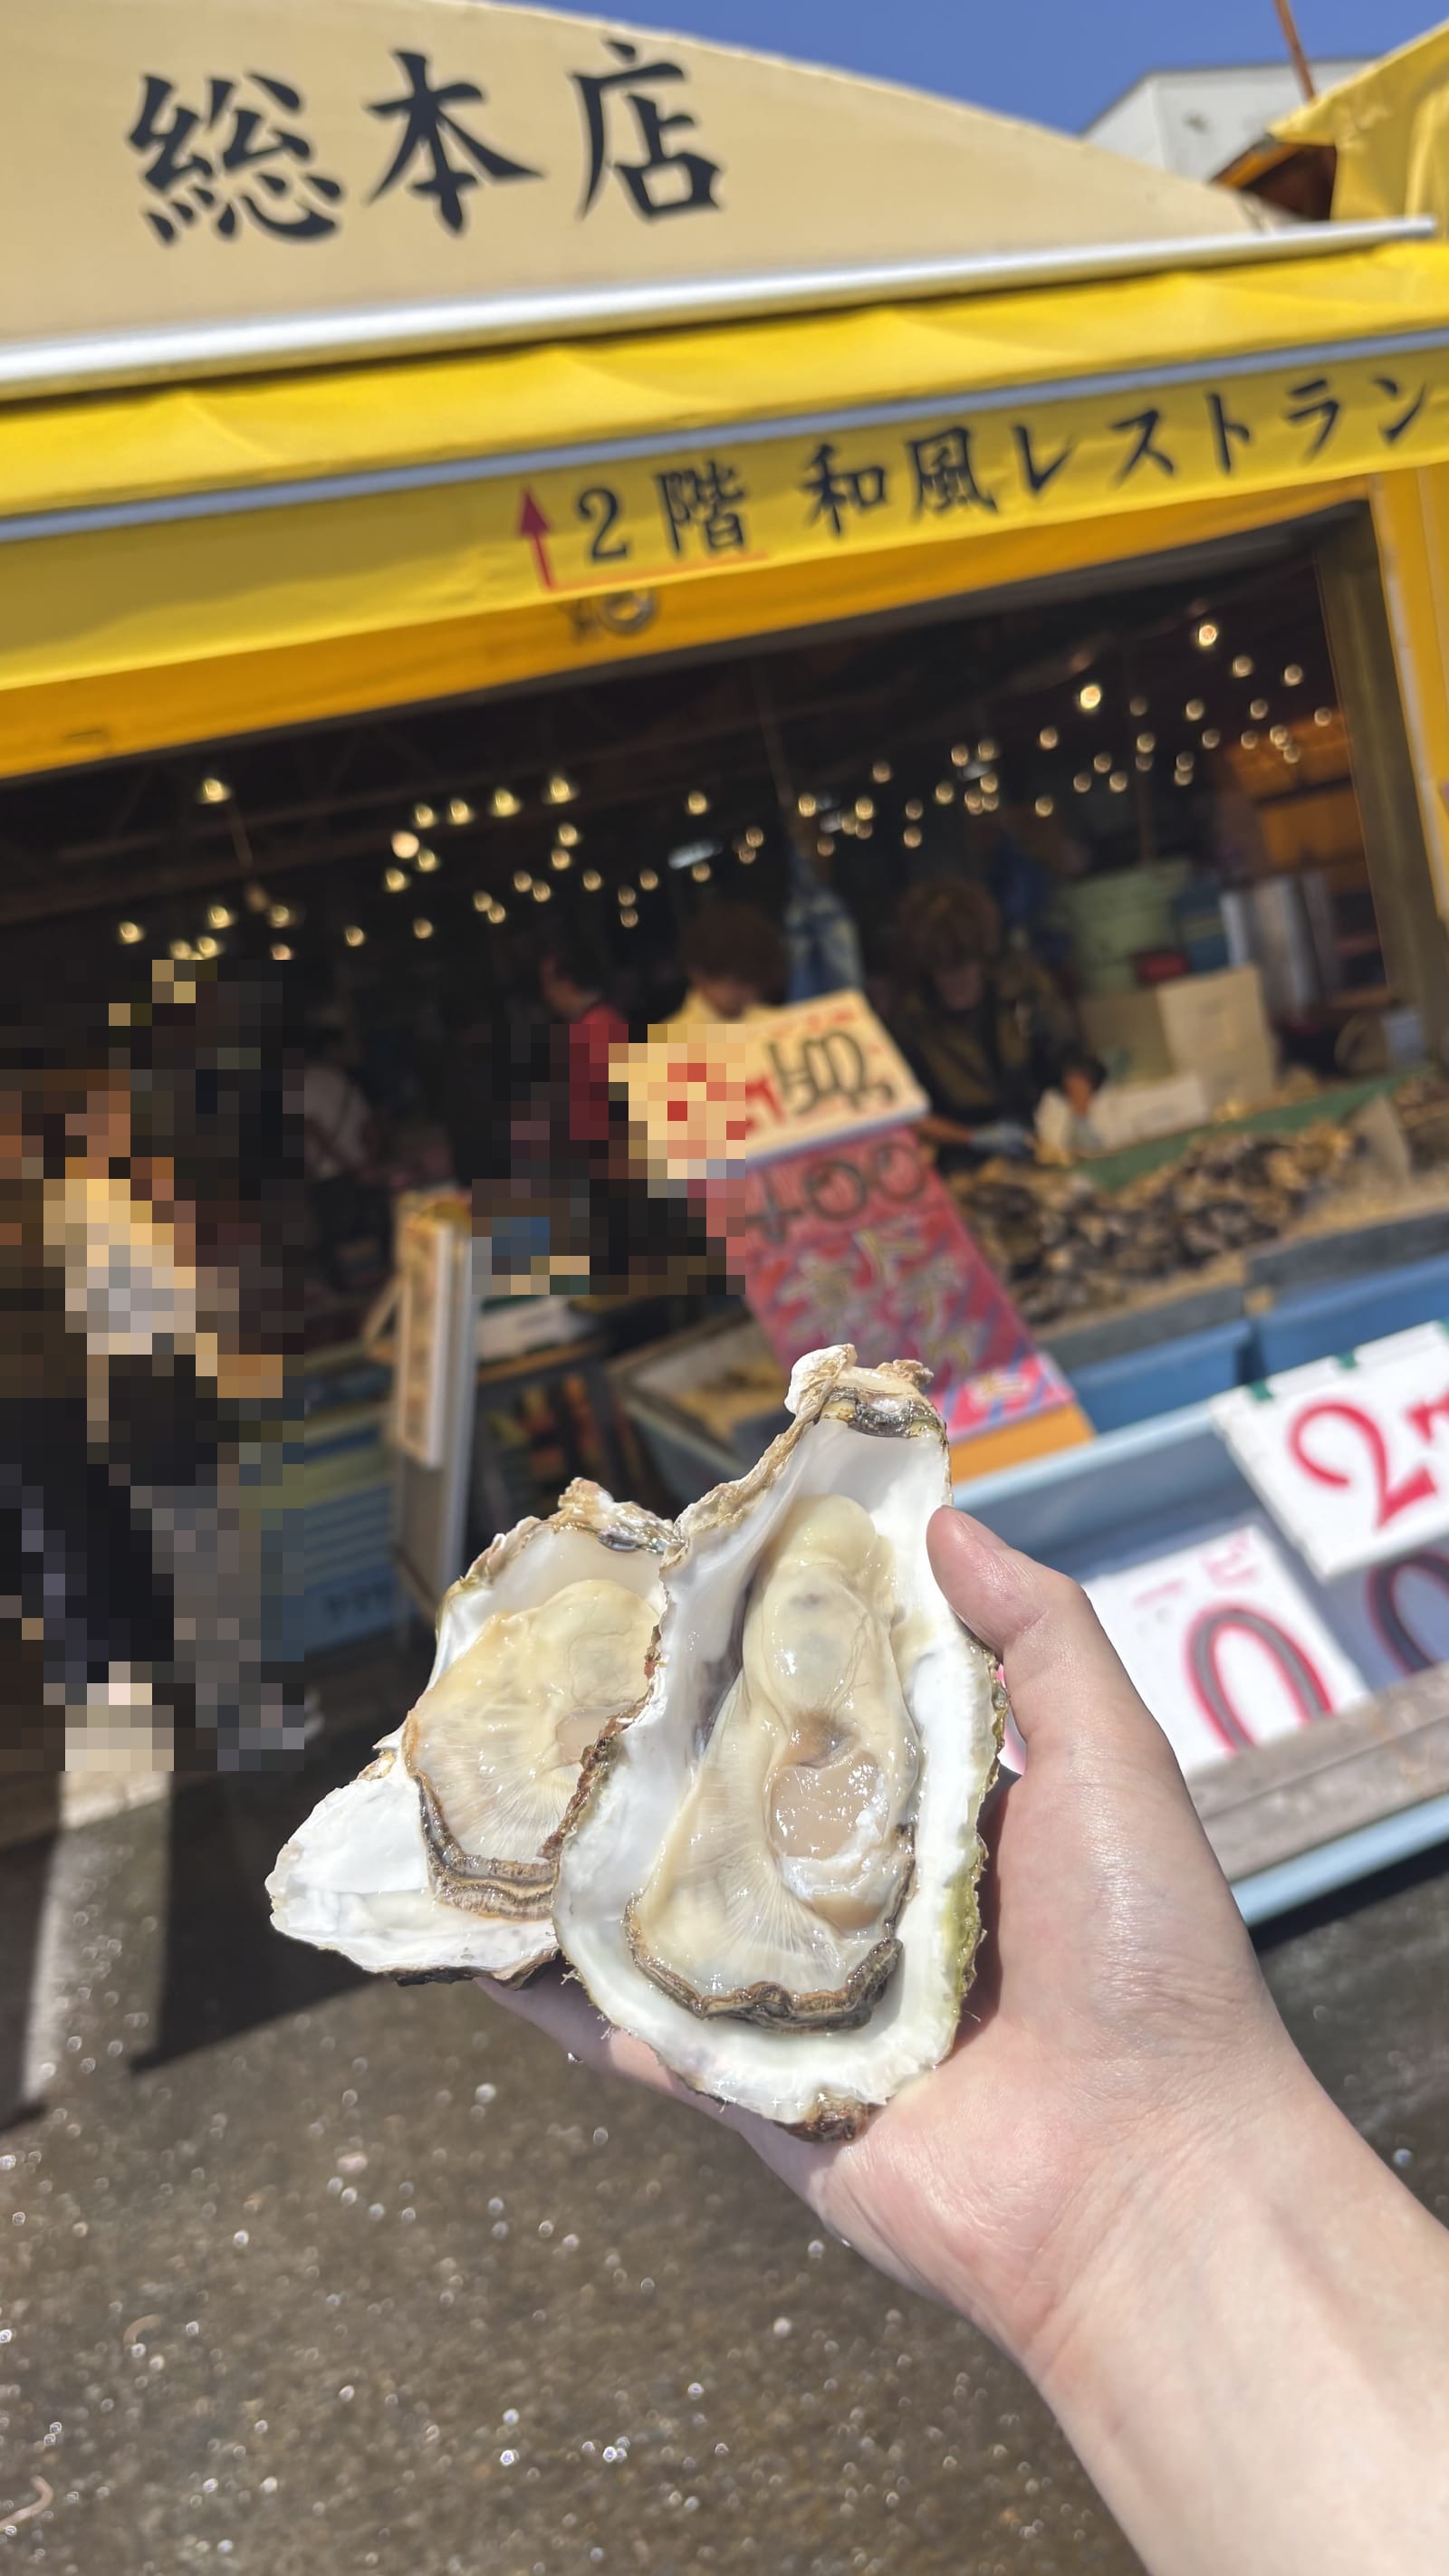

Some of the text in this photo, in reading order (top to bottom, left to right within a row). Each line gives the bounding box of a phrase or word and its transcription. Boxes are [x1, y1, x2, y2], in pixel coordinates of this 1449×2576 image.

[129, 40, 724, 245] 総本店
[575, 376, 1427, 565] 2階 和風レストラン
